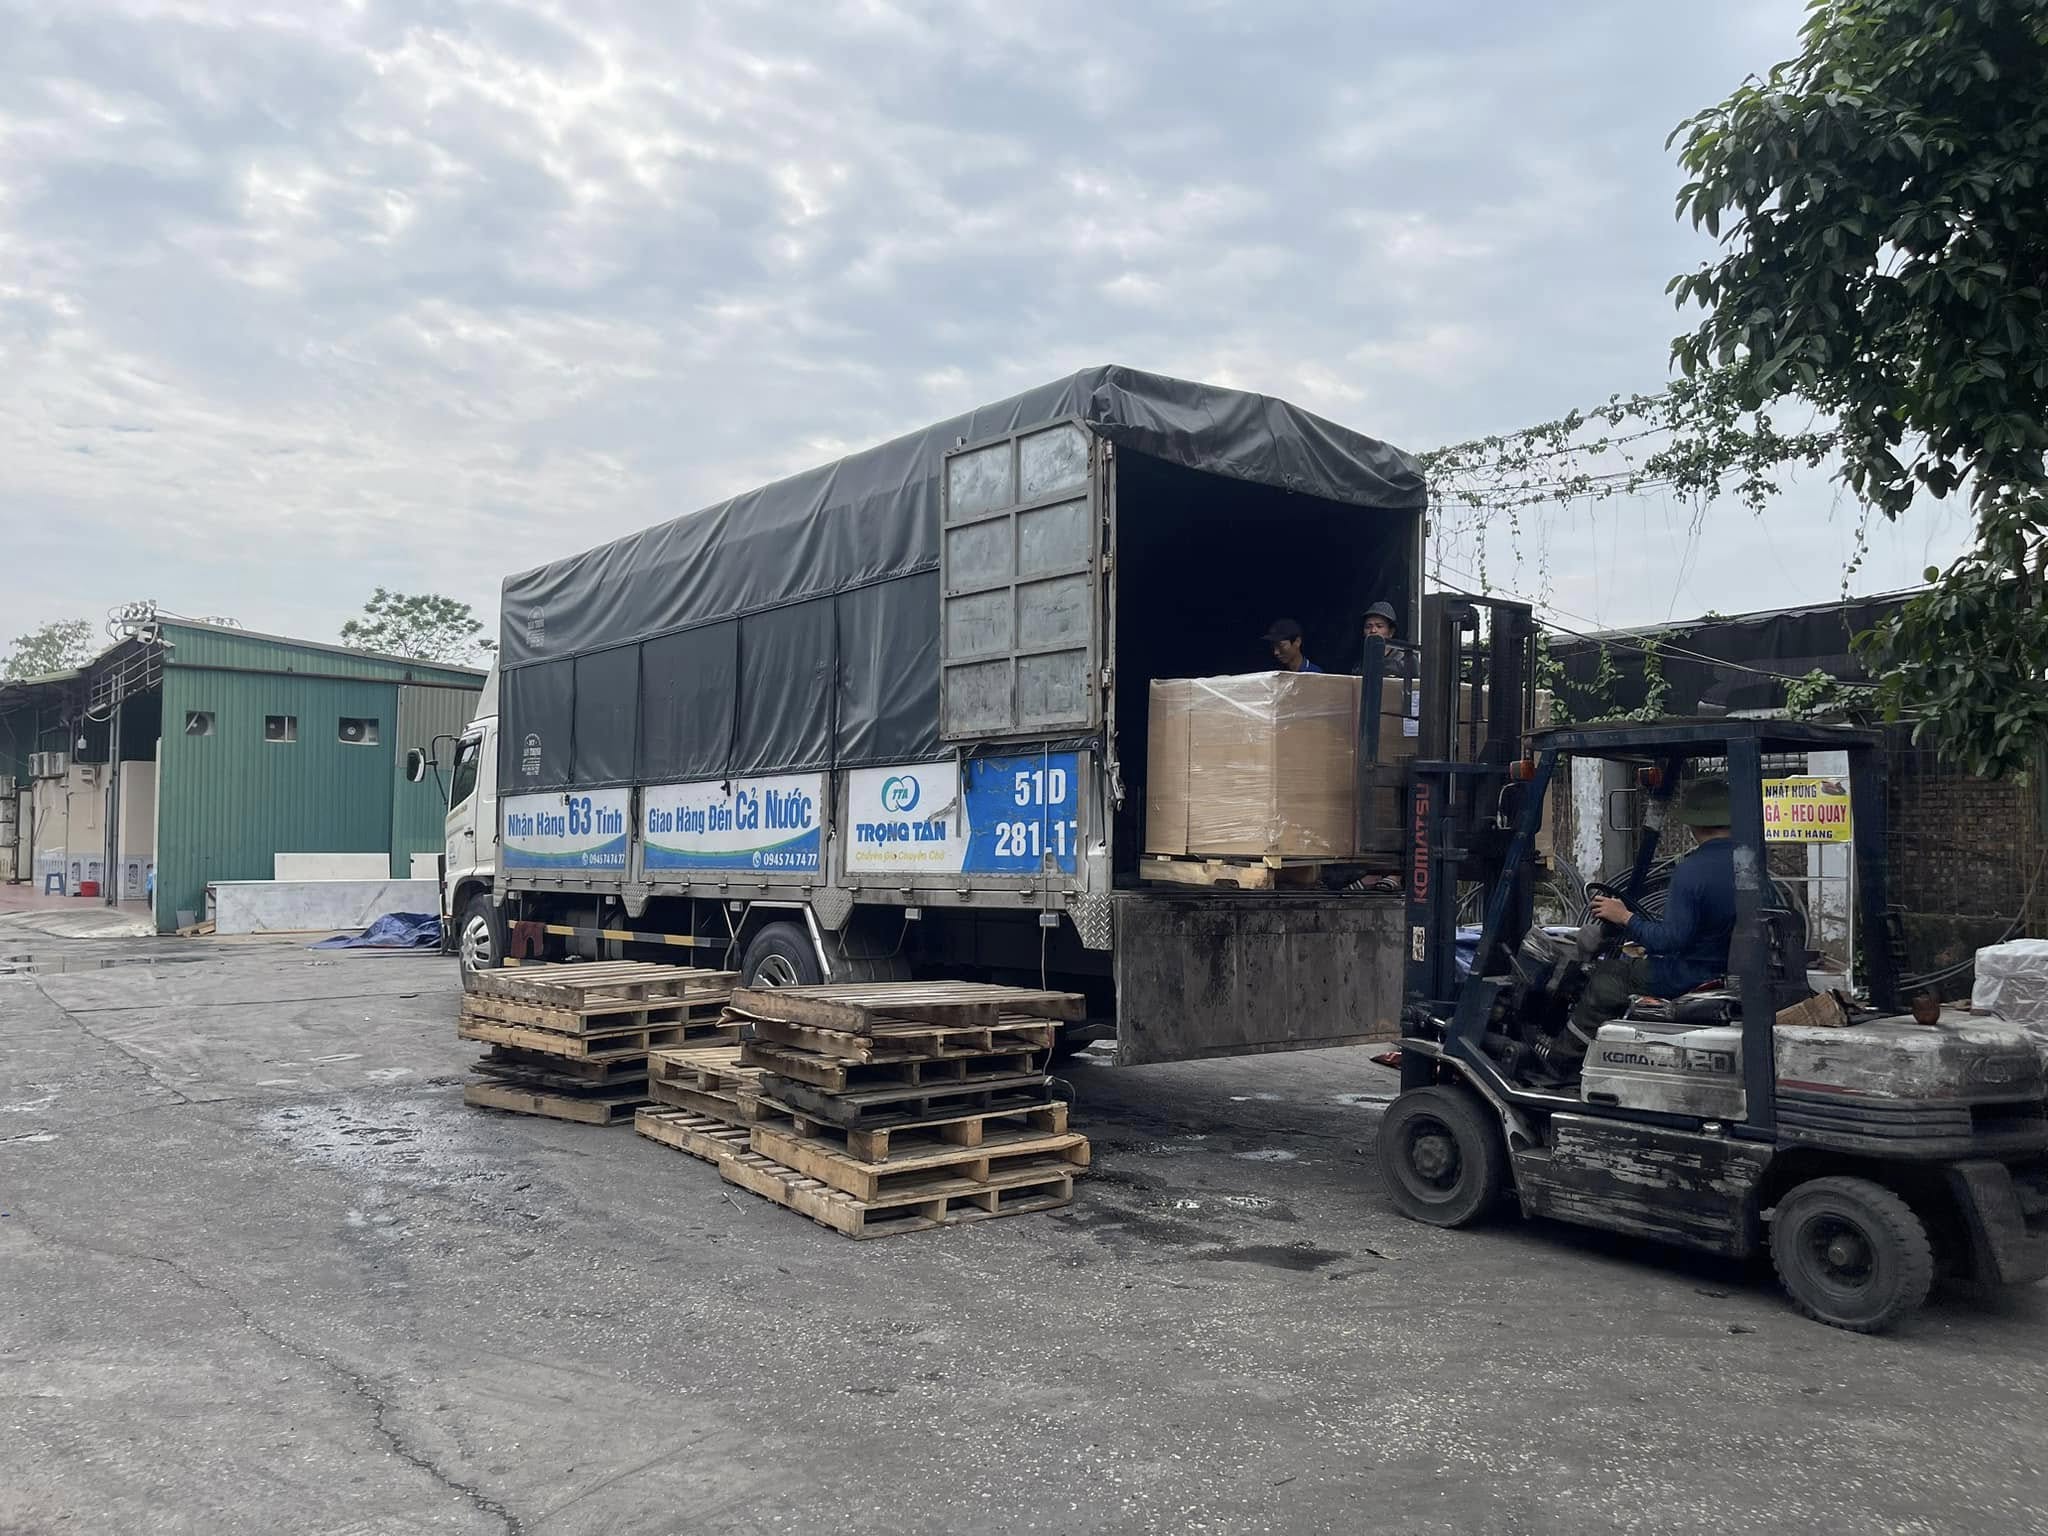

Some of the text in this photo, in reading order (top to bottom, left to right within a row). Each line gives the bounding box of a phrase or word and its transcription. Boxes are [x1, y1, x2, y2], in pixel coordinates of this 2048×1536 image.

[1015, 769, 1066, 806] 51D
[508, 797, 622, 841] Nhận Hàng 63 Tỉnh
[649, 787, 812, 835] Giao Hàng Đến Cả Nước
[1792, 804, 1815, 823] HEO
[1818, 804, 1846, 825] QUAY
[856, 822, 910, 847] TRỌNG
[1414, 784, 1430, 903] KOMATSU
